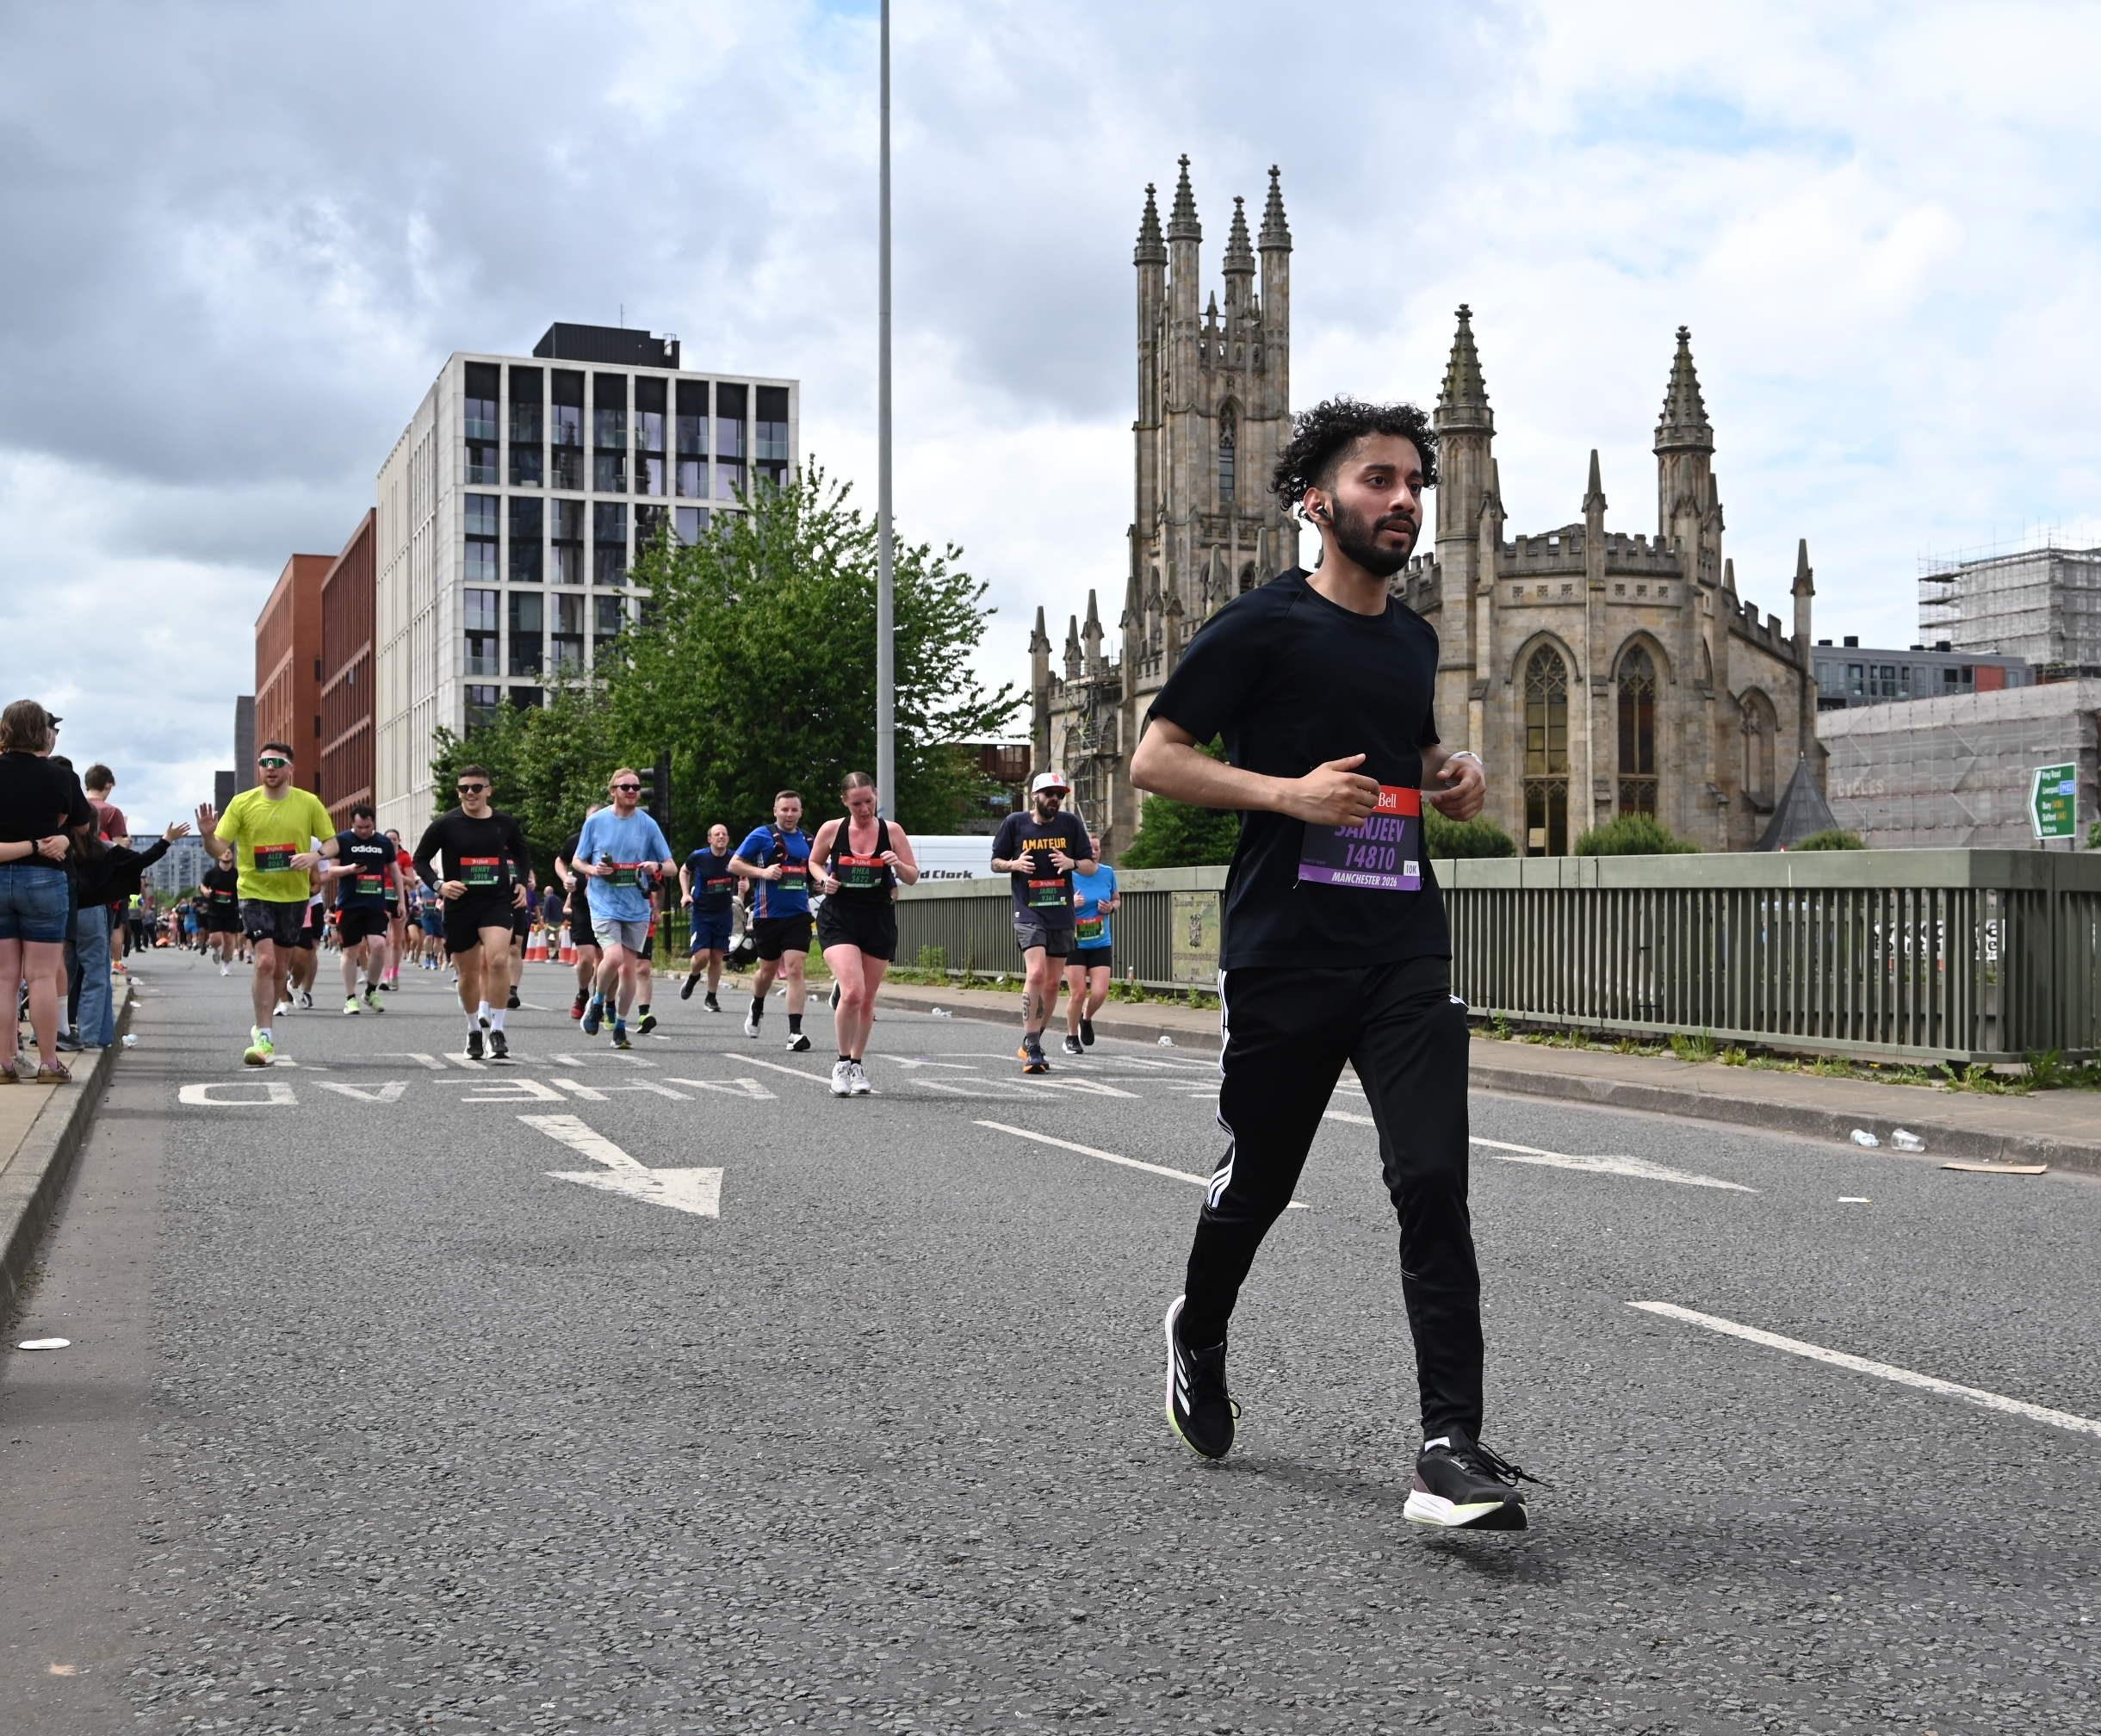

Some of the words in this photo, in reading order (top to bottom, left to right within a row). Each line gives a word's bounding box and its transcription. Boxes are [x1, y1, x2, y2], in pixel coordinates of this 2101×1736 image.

[1378, 791, 1397, 809] Bell
[350, 845, 383, 854] adidas
[1022, 837, 1067, 850] AMATEUR
[1345, 843, 1396, 871] 14810
[932, 870, 973, 879] Clark
[1405, 865, 1417, 875] 10K
[1331, 871, 1380, 886] MANCHESTER
[1381, 876, 1398, 888] 2026
[177, 1077, 778, 1106] AHEAD
